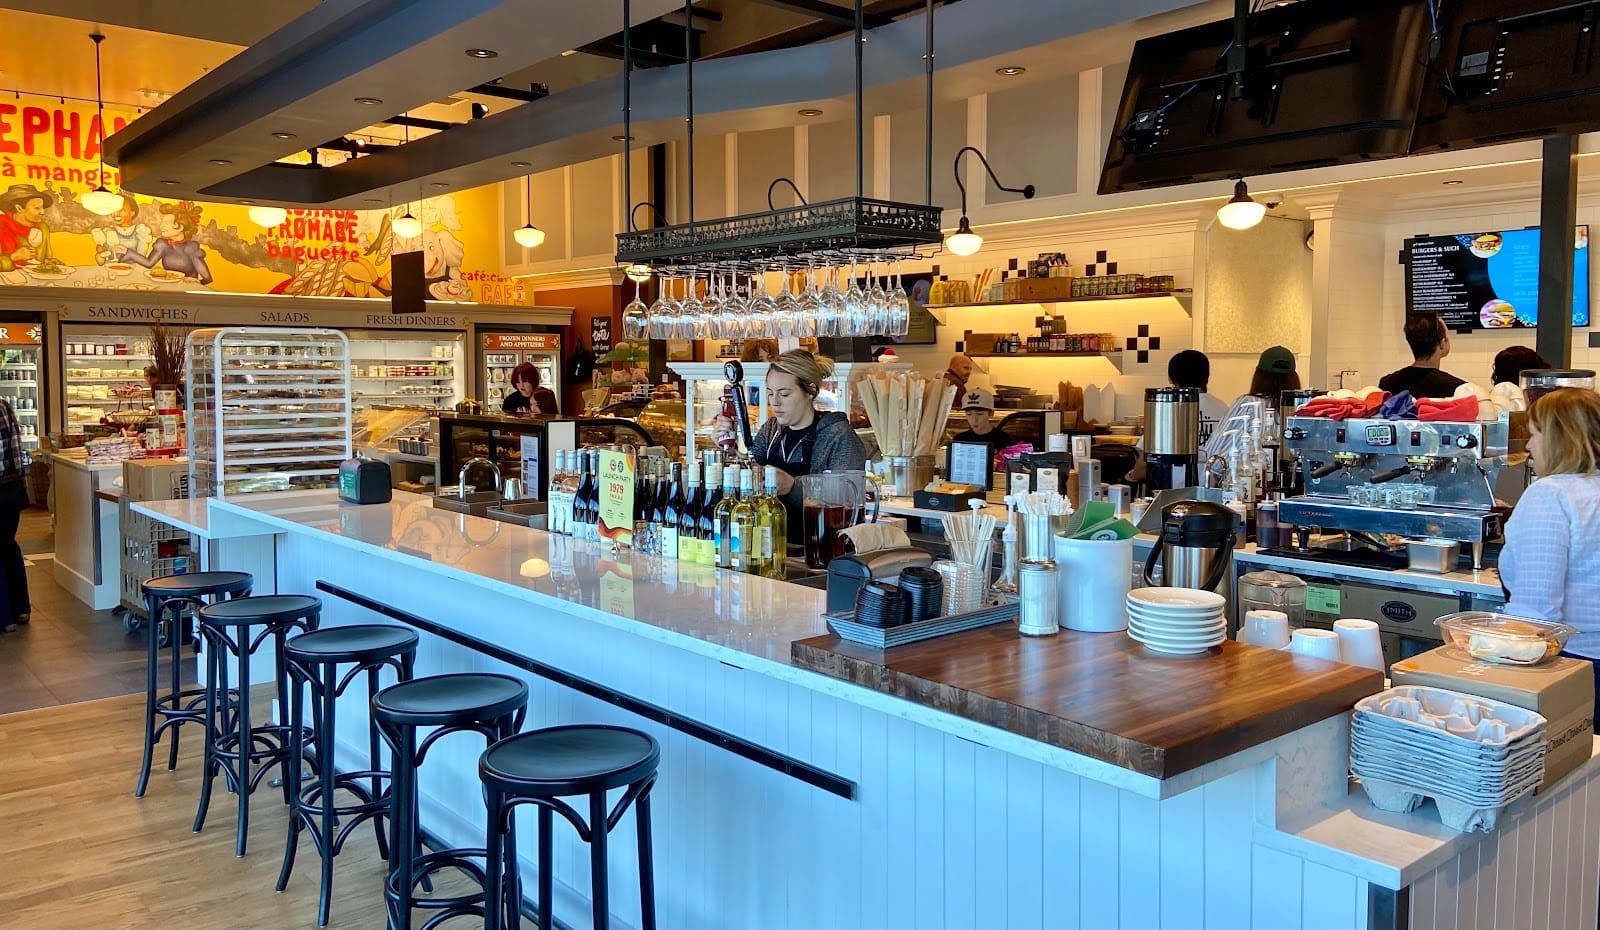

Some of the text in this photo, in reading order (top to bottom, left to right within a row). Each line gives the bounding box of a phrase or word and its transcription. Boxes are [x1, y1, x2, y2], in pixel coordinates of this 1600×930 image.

[266, 241, 360, 264] baguette
[88, 306, 188, 319] SANDWICHES
[260, 311, 310, 323] SALADS
[366, 314, 456, 326] FRESH DINNERS
[609, 482, 624, 495] 1979
